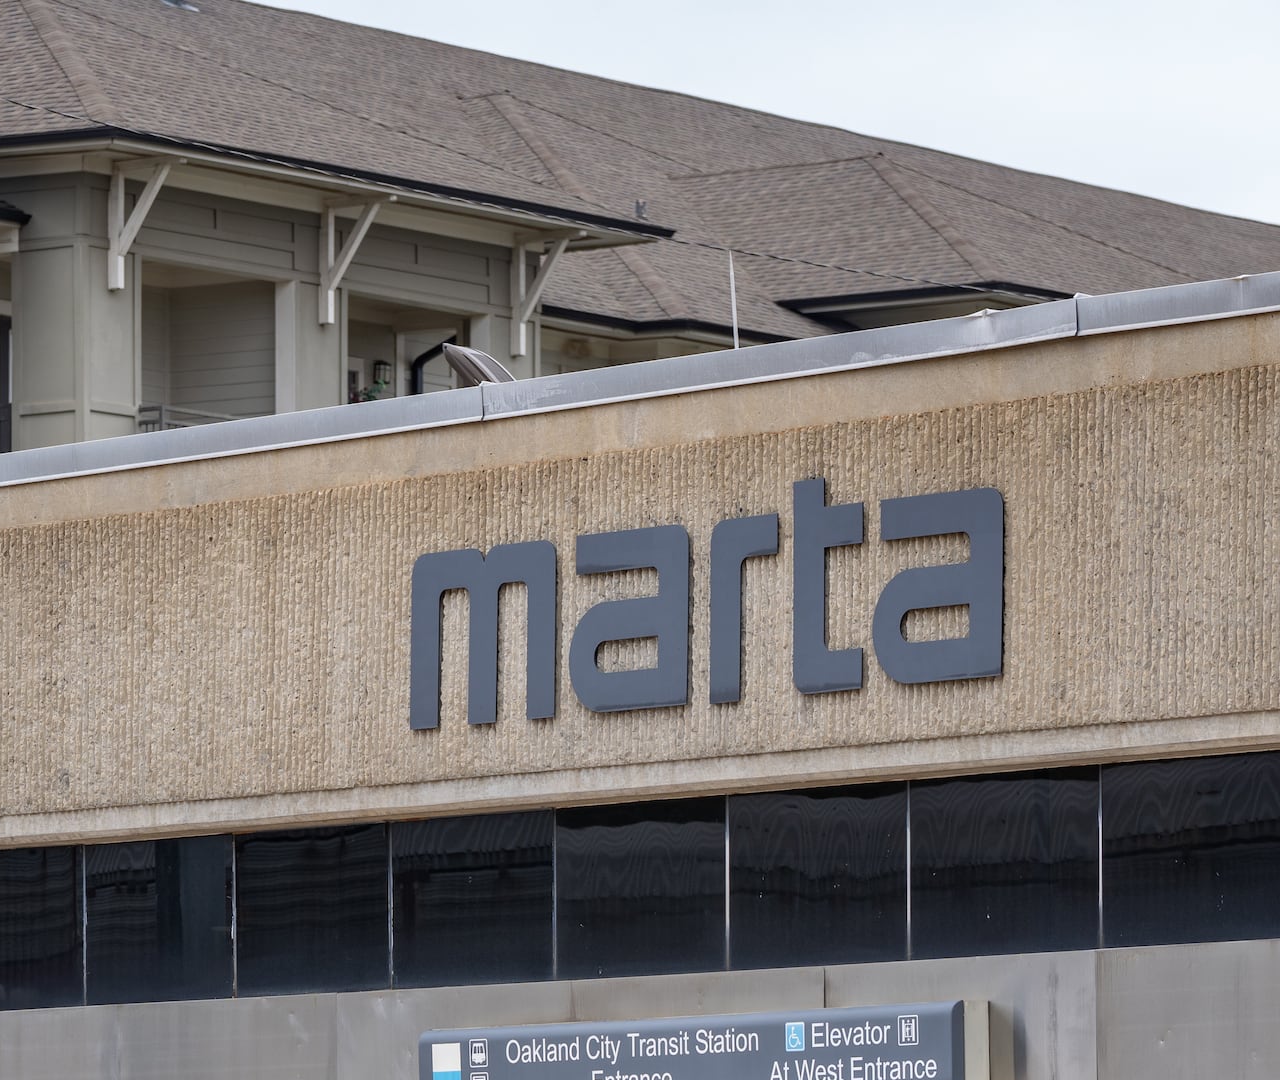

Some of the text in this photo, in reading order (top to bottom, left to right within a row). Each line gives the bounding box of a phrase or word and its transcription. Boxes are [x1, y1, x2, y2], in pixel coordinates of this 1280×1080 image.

[410, 477, 1005, 731] marta
[505, 1028, 760, 1064] Oakland City Transit Station
[810, 1019, 891, 1049] Elevator
[850, 1055, 938, 1080] Entrance
